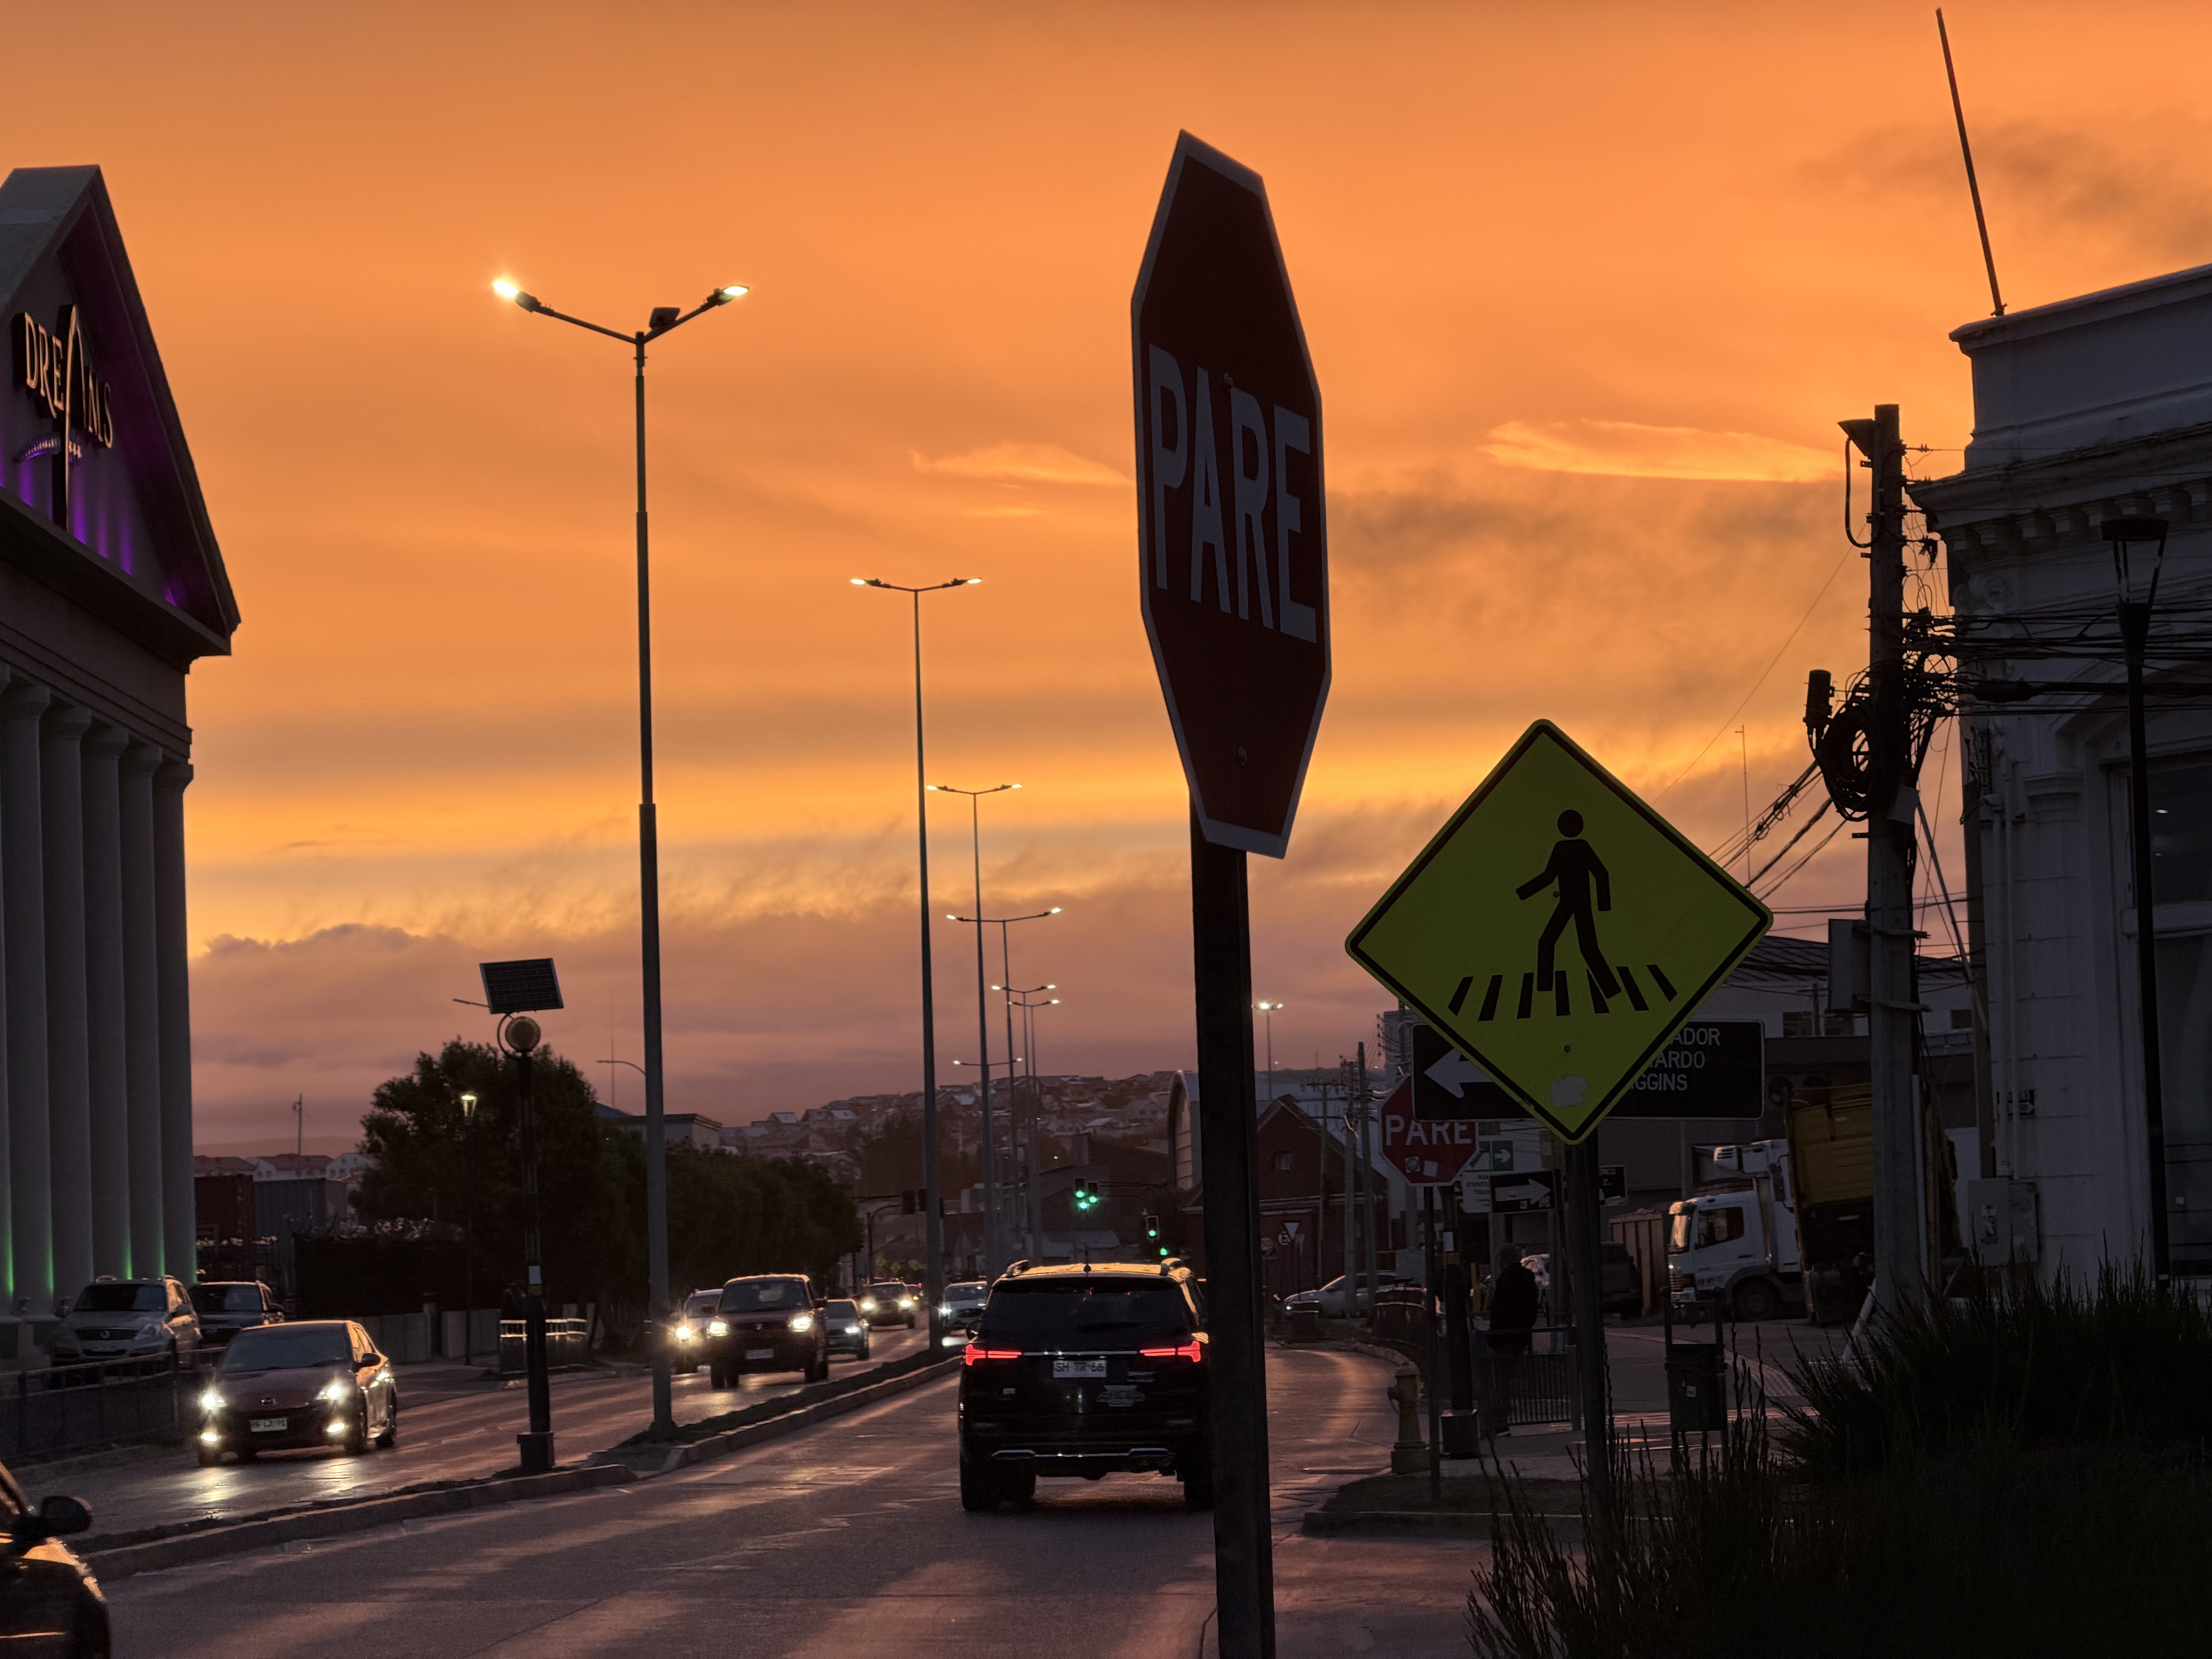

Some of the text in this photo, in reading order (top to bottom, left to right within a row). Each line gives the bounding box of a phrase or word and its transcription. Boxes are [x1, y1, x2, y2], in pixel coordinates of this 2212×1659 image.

[1149, 343, 1316, 643] PARE
[1650, 1050, 1706, 1069] ARDO
[1632, 1073, 1688, 1091] GGINS
[1385, 1115, 1472, 1146] PARE
